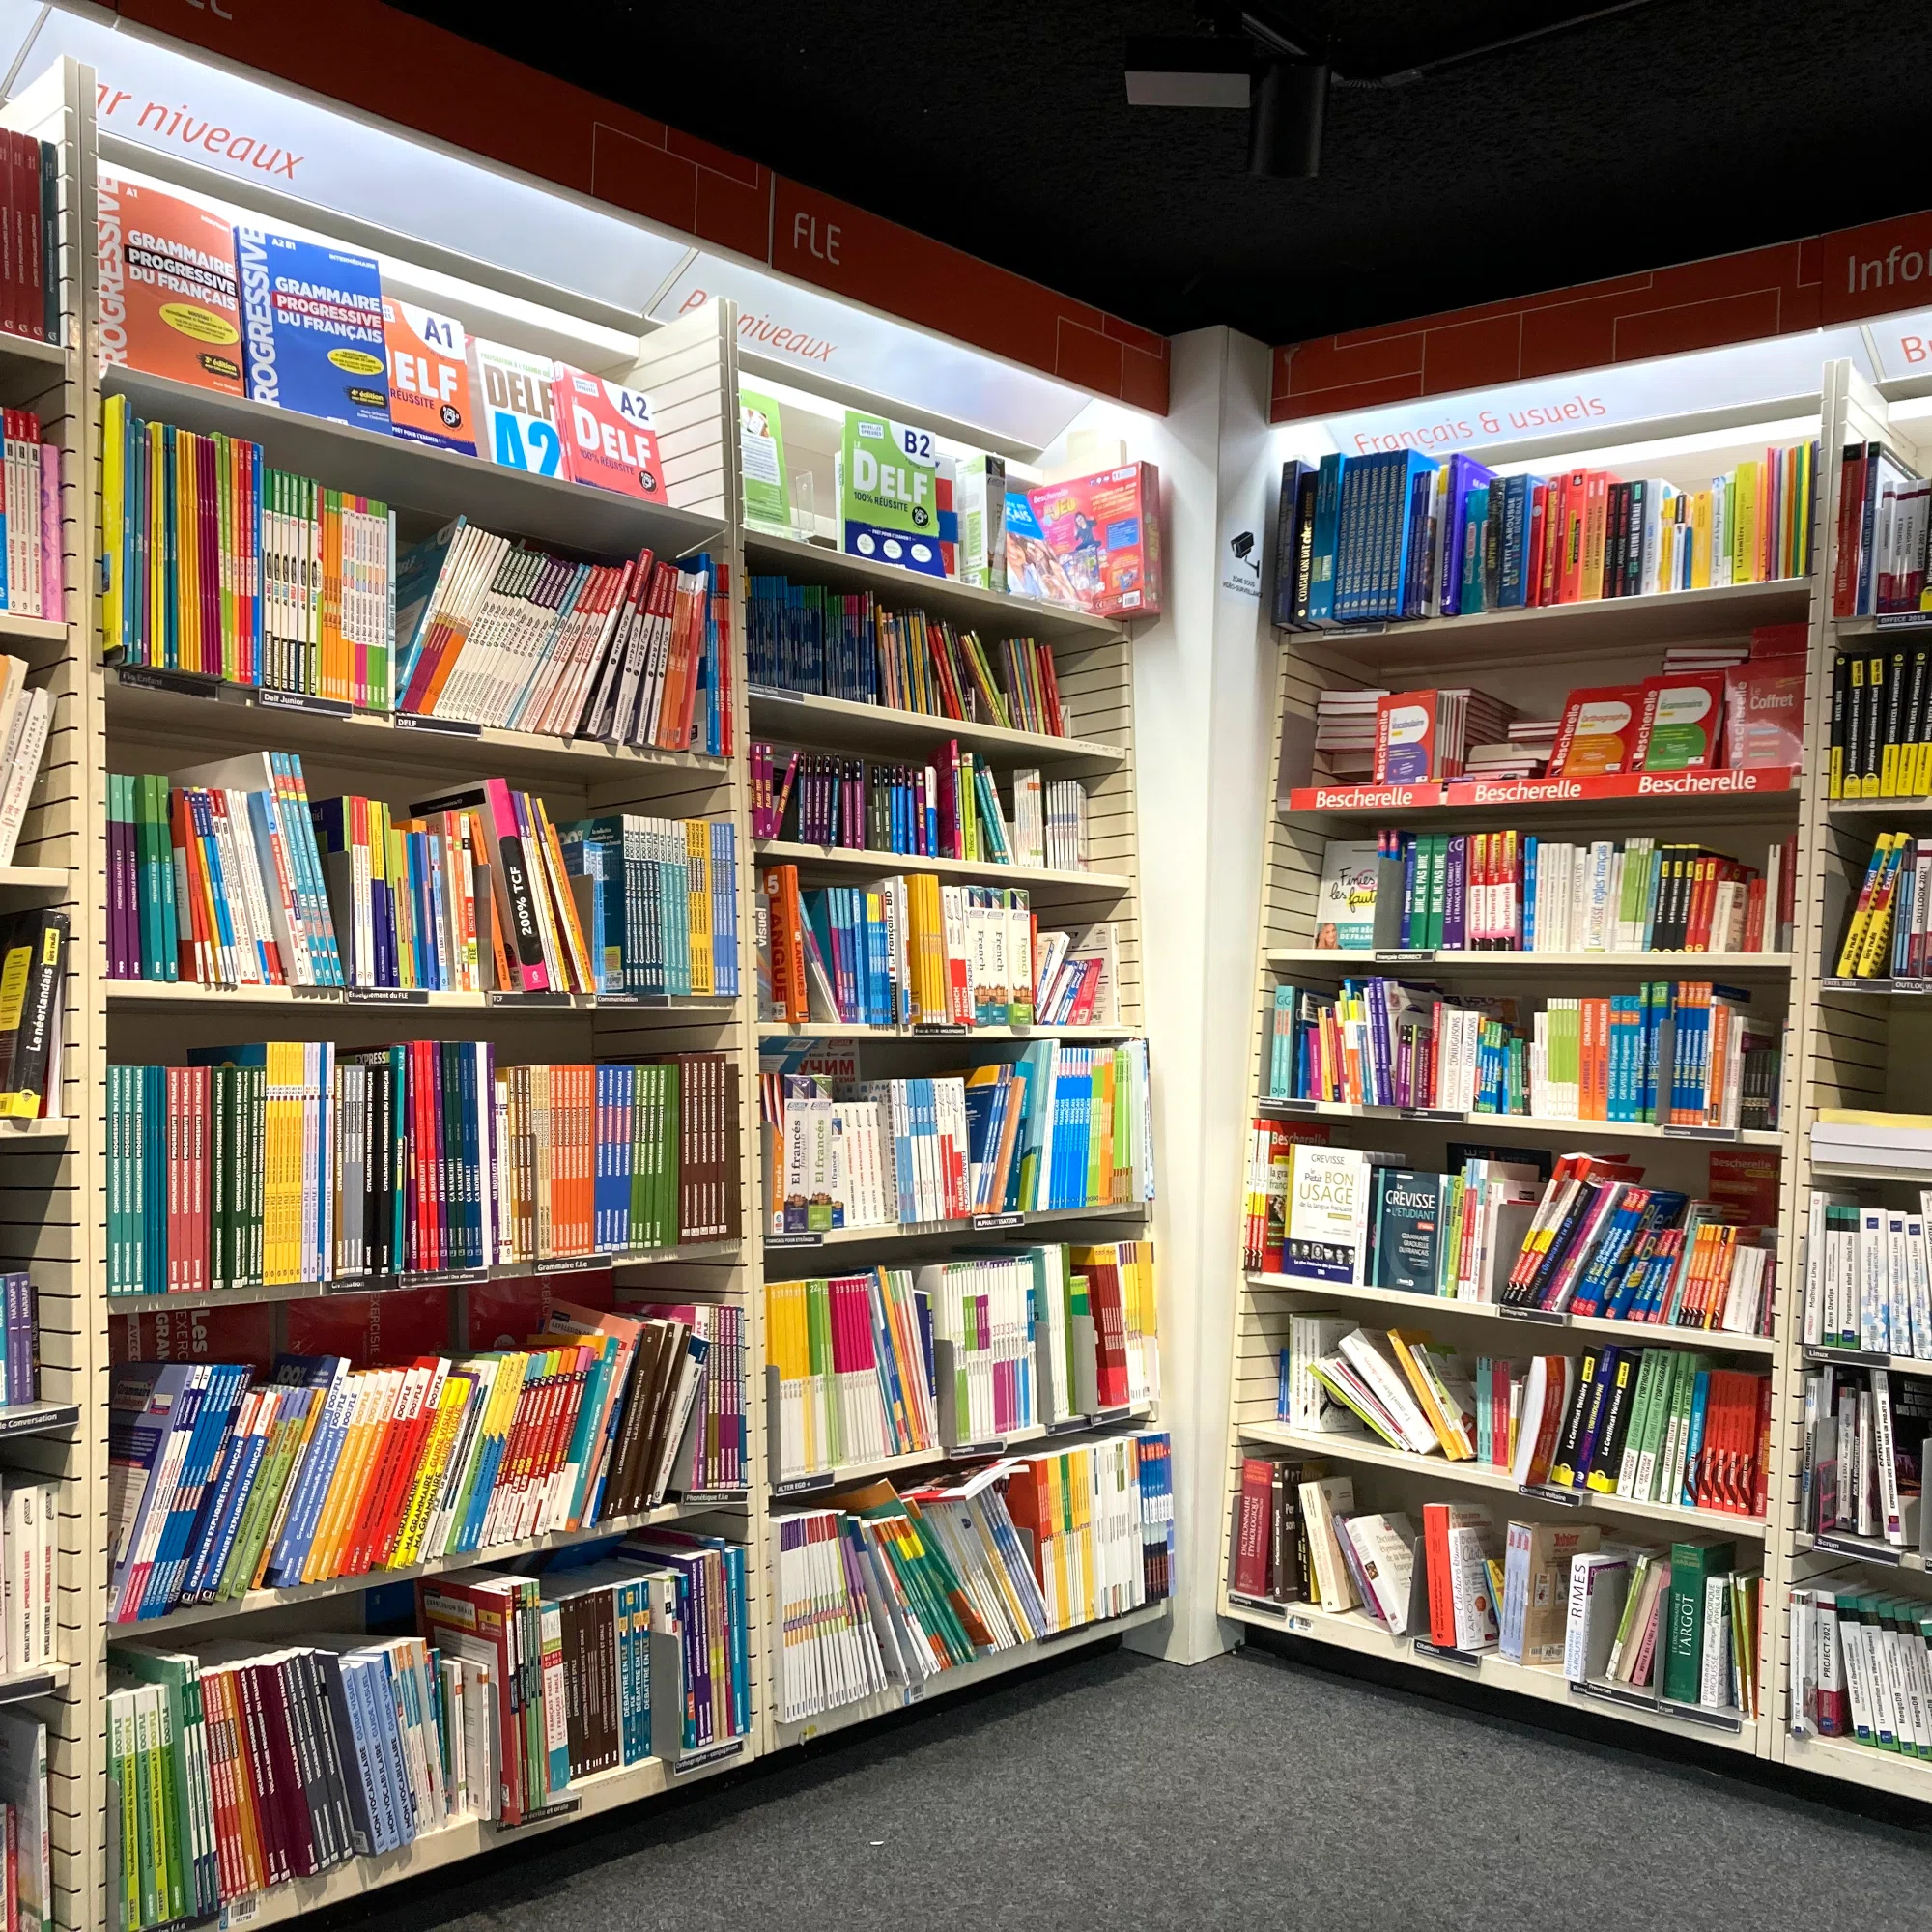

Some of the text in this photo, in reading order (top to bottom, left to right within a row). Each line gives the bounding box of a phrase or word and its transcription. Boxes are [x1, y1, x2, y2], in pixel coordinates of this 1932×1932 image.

[136, 99, 305, 180] niveaux
[125, 187, 139, 199] A1
[128, 229, 235, 278] GRAMMAIRE
[794, 212, 841, 266] FLE
[128, 248, 237, 297] PROGRESSIVE
[1848, 244, 1932, 293] Info
[128, 266, 237, 312] DU FRANÇAIS
[274, 276, 381, 312] GRAMMAIRE
[276, 294, 383, 328] PROGRESSIVE
[277, 309, 383, 345] DU FRANÇAIS
[424, 315, 454, 349] A1
[738, 314, 838, 362] niveaux
[390, 387, 435, 411] RÉUSSITE
[482, 363, 554, 421] DELF
[620, 390, 650, 422] A2
[571, 404, 652, 469] DELF
[1353, 395, 1606, 455] Français & usuels
[494, 410, 561, 478] A2
[580, 449, 635, 475] 100% RÉUSSITE
[904, 429, 930, 459] B2
[853, 447, 928, 504] DELF
[854, 491, 909, 513] 100% RÉUSSITE
[264, 692, 304, 706] Delf Junior
[1749, 693, 1794, 711] Coffret
[1750, 685, 1761, 696] Le
[397, 719, 417, 728] DELF
[1552, 703, 1580, 766] Bescherelle
[1633, 689, 1658, 760] Bescherelle
[1376, 709, 1388, 781] Bescherelle
[1315, 787, 1413, 809] Bescherelle
[1474, 779, 1582, 803] Bescherelle
[1638, 771, 1757, 794] Bescherelle
[767, 875, 780, 895] 5
[1330, 883, 1348, 901] les
[1338, 867, 1377, 886] Finies
[1863, 869, 1877, 892] Excel
[510, 866, 533, 936] 200% TCF
[886, 890, 893, 906] BD
[1916, 866, 1928, 924] OUTLOOK 2021
[756, 907, 767, 947] visuel
[469, 947, 478, 962] FLE
[794, 931, 805, 998] 5 LANGUES
[978, 929, 986, 972] French
[996, 930, 1005, 972] French
[33, 967, 53, 1036] néerlandais
[1449, 1017, 1461, 1065] CONJUGAISONS
[1466, 1017, 1478, 1067] CONJUGAISONS
[1583, 1003, 1592, 1046] CONJUGAISON
[792, 1120, 801, 1185] El francés
[815, 1120, 824, 1183] El francés
[1271, 1131, 1327, 1146] Bescherelle
[1269, 1168, 1275, 1177] la
[1311, 1153, 1346, 1165] GREVISSE
[1712, 1158, 1772, 1170] Bescherelle
[1299, 1182, 1354, 1205] USAGE
[1304, 1171, 1354, 1186] Petit BON
[1312, 1203, 1328, 1211] langue
[1385, 1189, 1436, 1209] GREVISSE
[537, 1262, 573, 1271] Grammaire
[1501, 1307, 1528, 1317] Orthographe
[129, 1324, 139, 1352] AVEC
[191, 1309, 210, 1353] Les
[1809, 1350, 1829, 1359] Linux
[8, 1413, 58, 1429] Conversation
[580, 1404, 601, 1480] Grammaire français
[1804, 1432, 1813, 1470] computing
[413, 1403, 464, 1553] MA GRAMMAIRE VISUEL
[525, 1457, 533, 1474] 500
[1639, 1454, 1648, 1484] CERTIFICAT
[1643, 1459, 1653, 1483] VOLTAIRE
[686, 1492, 714, 1501] Phonétique
[778, 1484, 793, 1492] ALTER
[1545, 1490, 1567, 1502] Voltaire
[189, 1439, 244, 1587] GRAMMAIRE EXPLIQUÉE FRANÇAIS
[1241, 1496, 1251, 1557] DICTIONNAIRE
[1248, 1496, 1258, 1558] ÉTYMOLOGIQUE
[1817, 1538, 1840, 1549] Scrum
[1463, 1573, 1476, 1641] LAROUSSE
[1572, 1563, 1587, 1619] RIMES
[1706, 1583, 1715, 1627] ARGOTIQUE
[1713, 1585, 1721, 1627] POPULAIRE
[1679, 1594, 1695, 1657] L'ARGOT
[1566, 1629, 1575, 1676] Dictionnaire
[1572, 1630, 1582, 1679] LAROUSSE
[1702, 1653, 1711, 1701] Dictionnaire
[1709, 1655, 1719, 1704] LAROUSSE
[1894, 1692, 1906, 1724] MongoDB
[1910, 1696, 1922, 1728] MongoDB
[347, 1674, 384, 1838] MON VOCABULAIRE GUIDE VISUEL
[676, 1753, 707, 1769] Orthographe
[553, 1803, 569, 1812] orale
